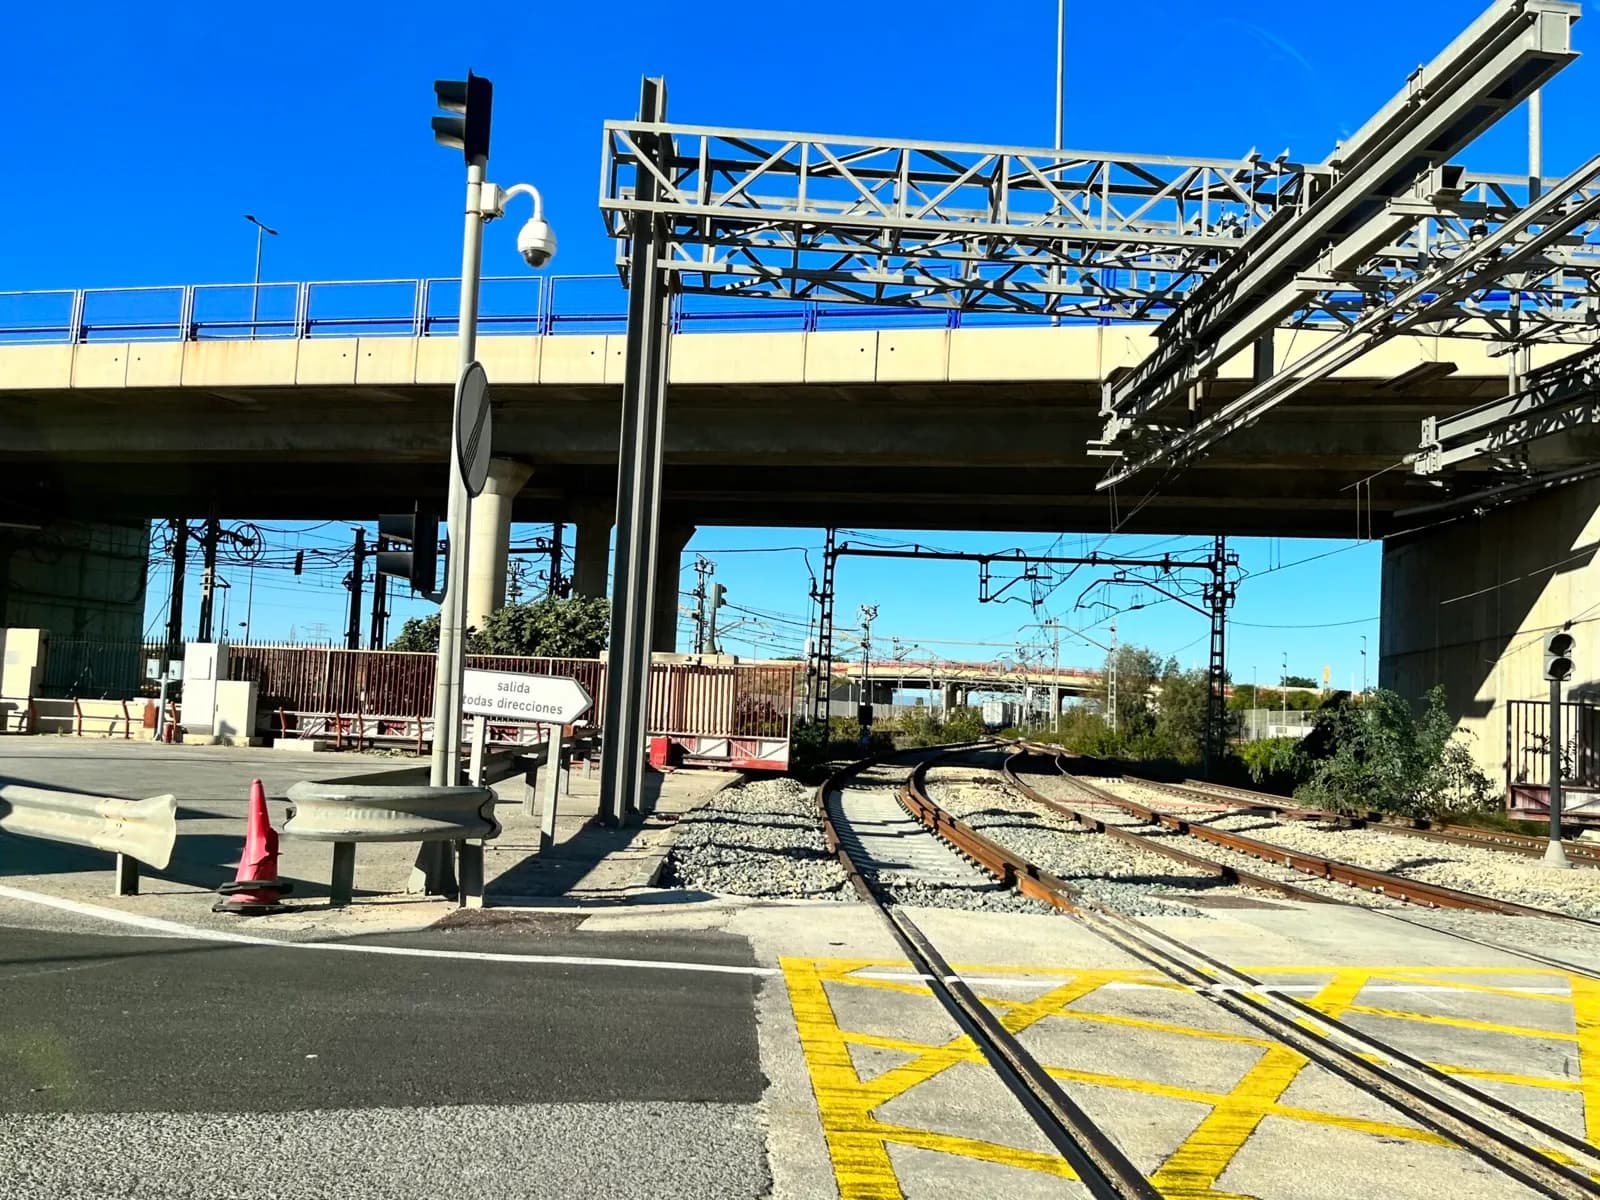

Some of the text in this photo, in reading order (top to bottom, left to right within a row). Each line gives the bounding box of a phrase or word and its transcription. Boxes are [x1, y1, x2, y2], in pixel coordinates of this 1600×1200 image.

[497, 681, 530, 694] salida
[463, 694, 563, 715] todas direcciones
